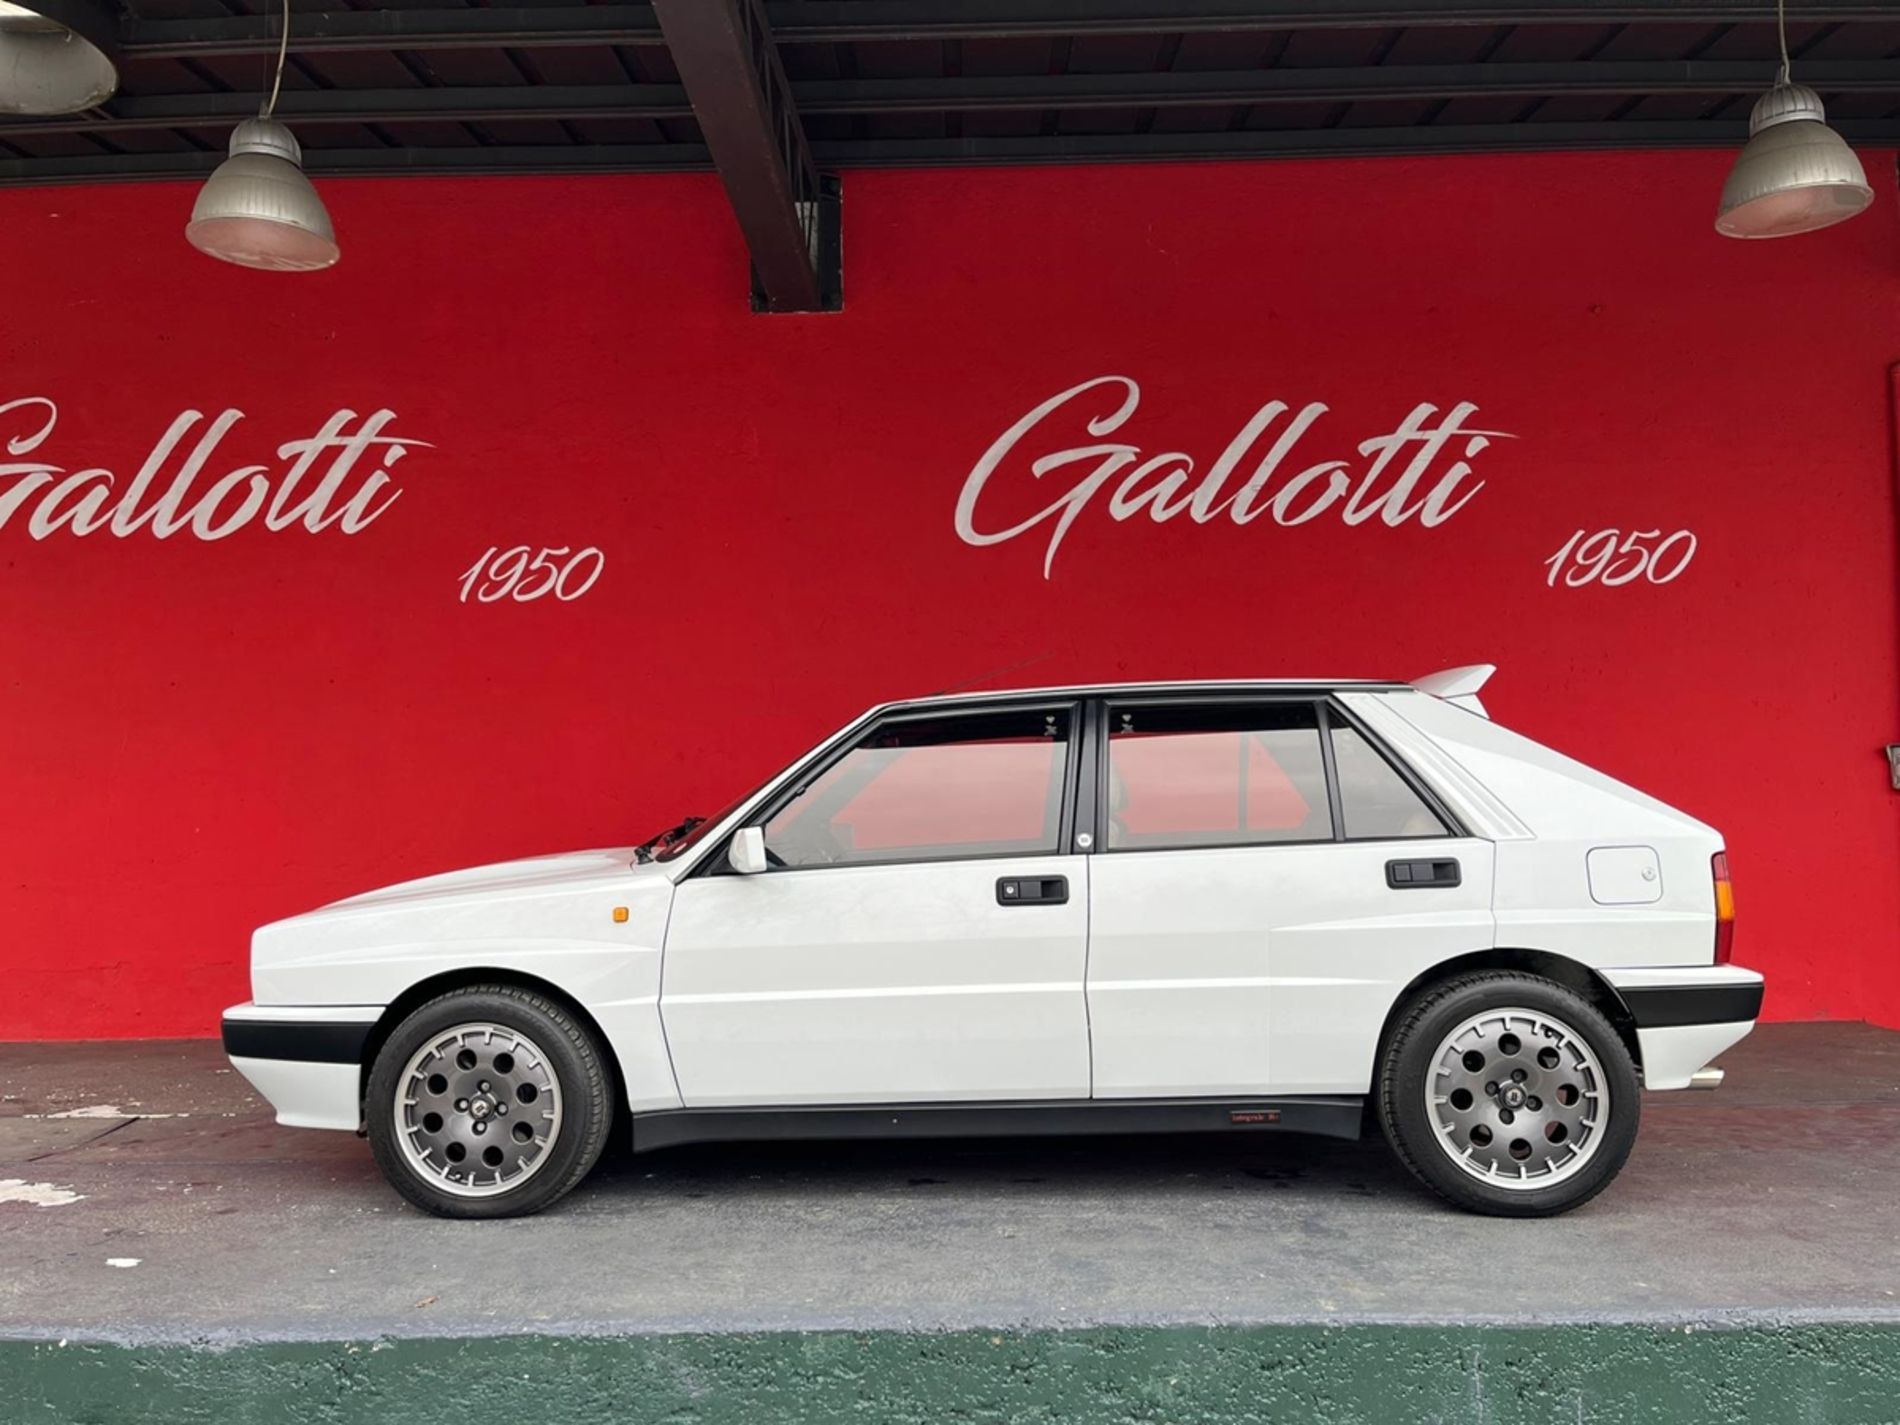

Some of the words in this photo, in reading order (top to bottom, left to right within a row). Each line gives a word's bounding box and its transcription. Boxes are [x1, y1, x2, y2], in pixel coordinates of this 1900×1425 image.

[954, 375, 1518, 580] Gallotti
[459, 545, 605, 603] 1950
[1544, 528, 1697, 588] 1950
